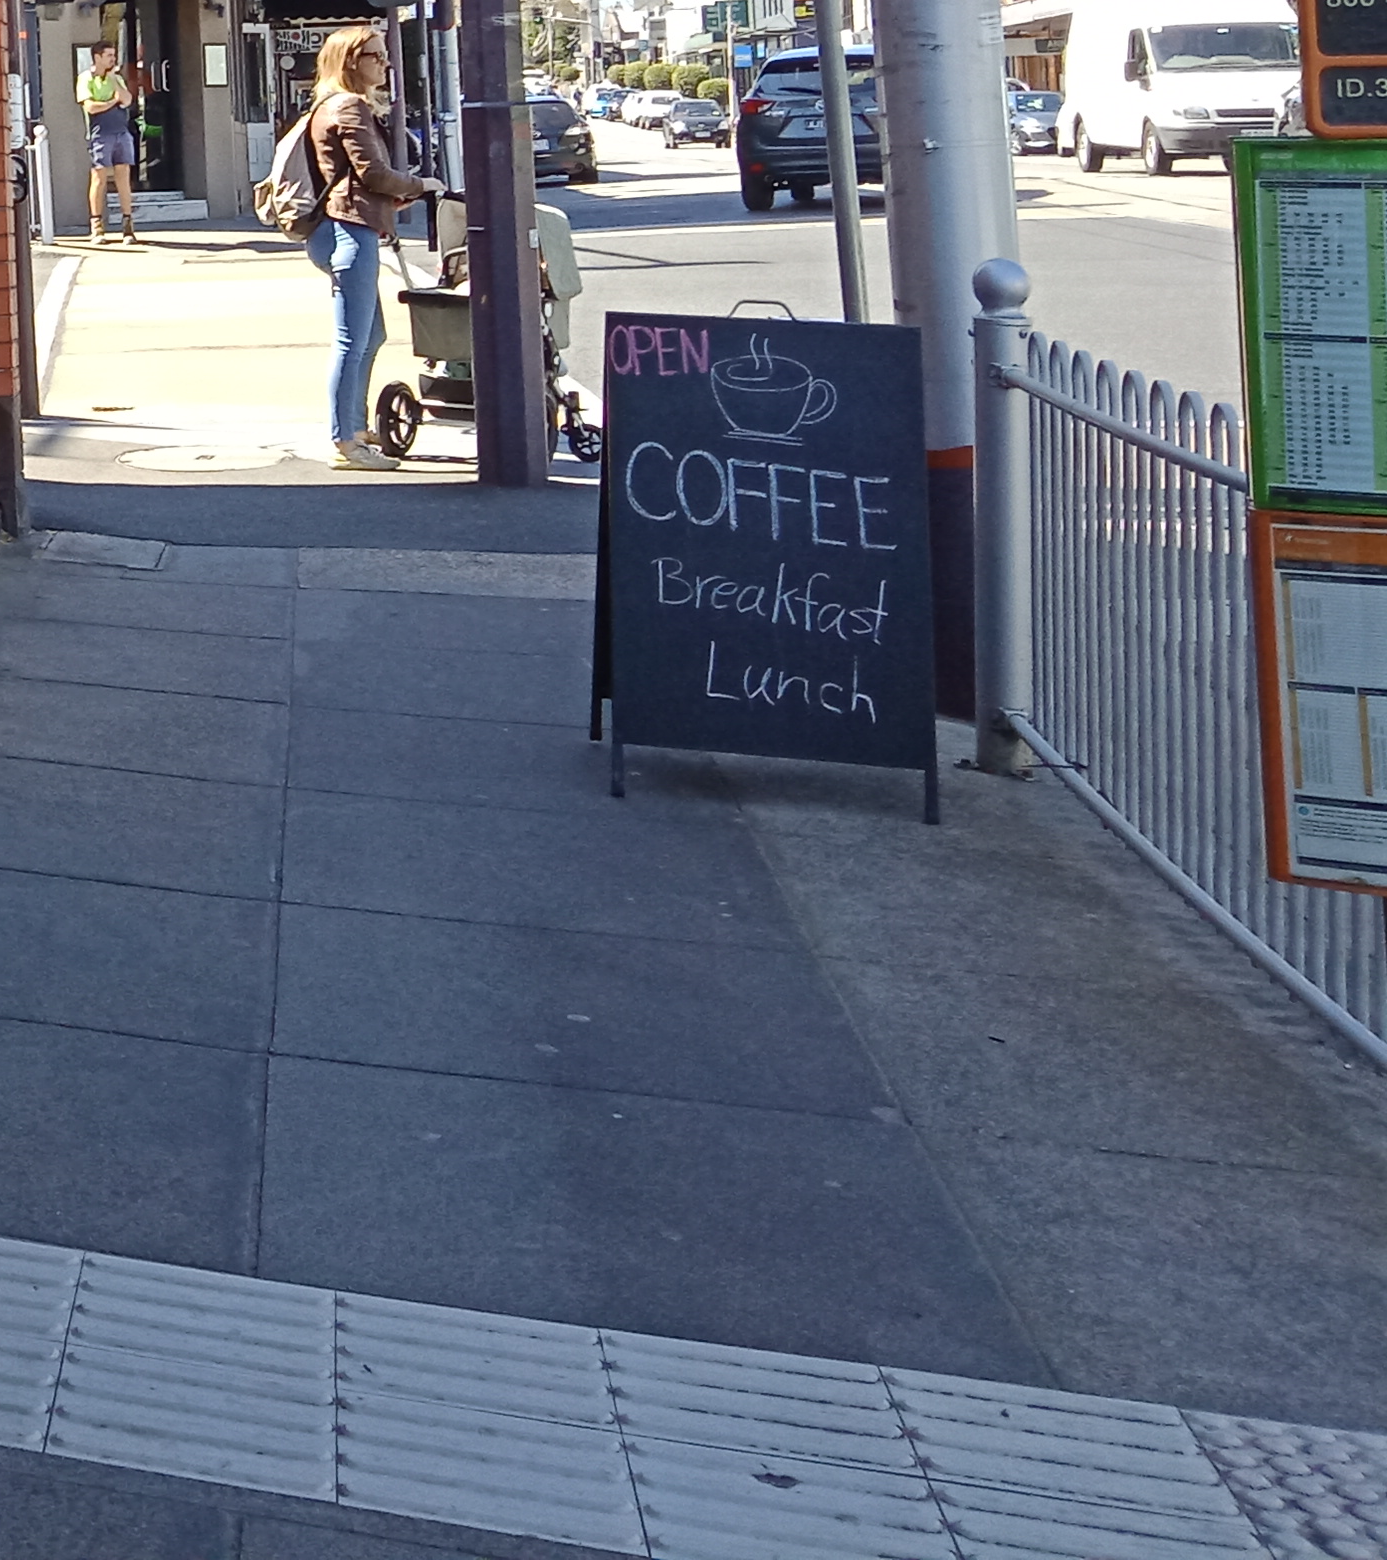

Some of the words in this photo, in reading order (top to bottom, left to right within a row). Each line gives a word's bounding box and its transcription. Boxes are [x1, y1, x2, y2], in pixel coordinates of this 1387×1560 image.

[610, 325, 710, 376] OPEN
[626, 441, 898, 551] COFFEE
[651, 556, 889, 645] Breakfast
[705, 640, 877, 725] Lunch
